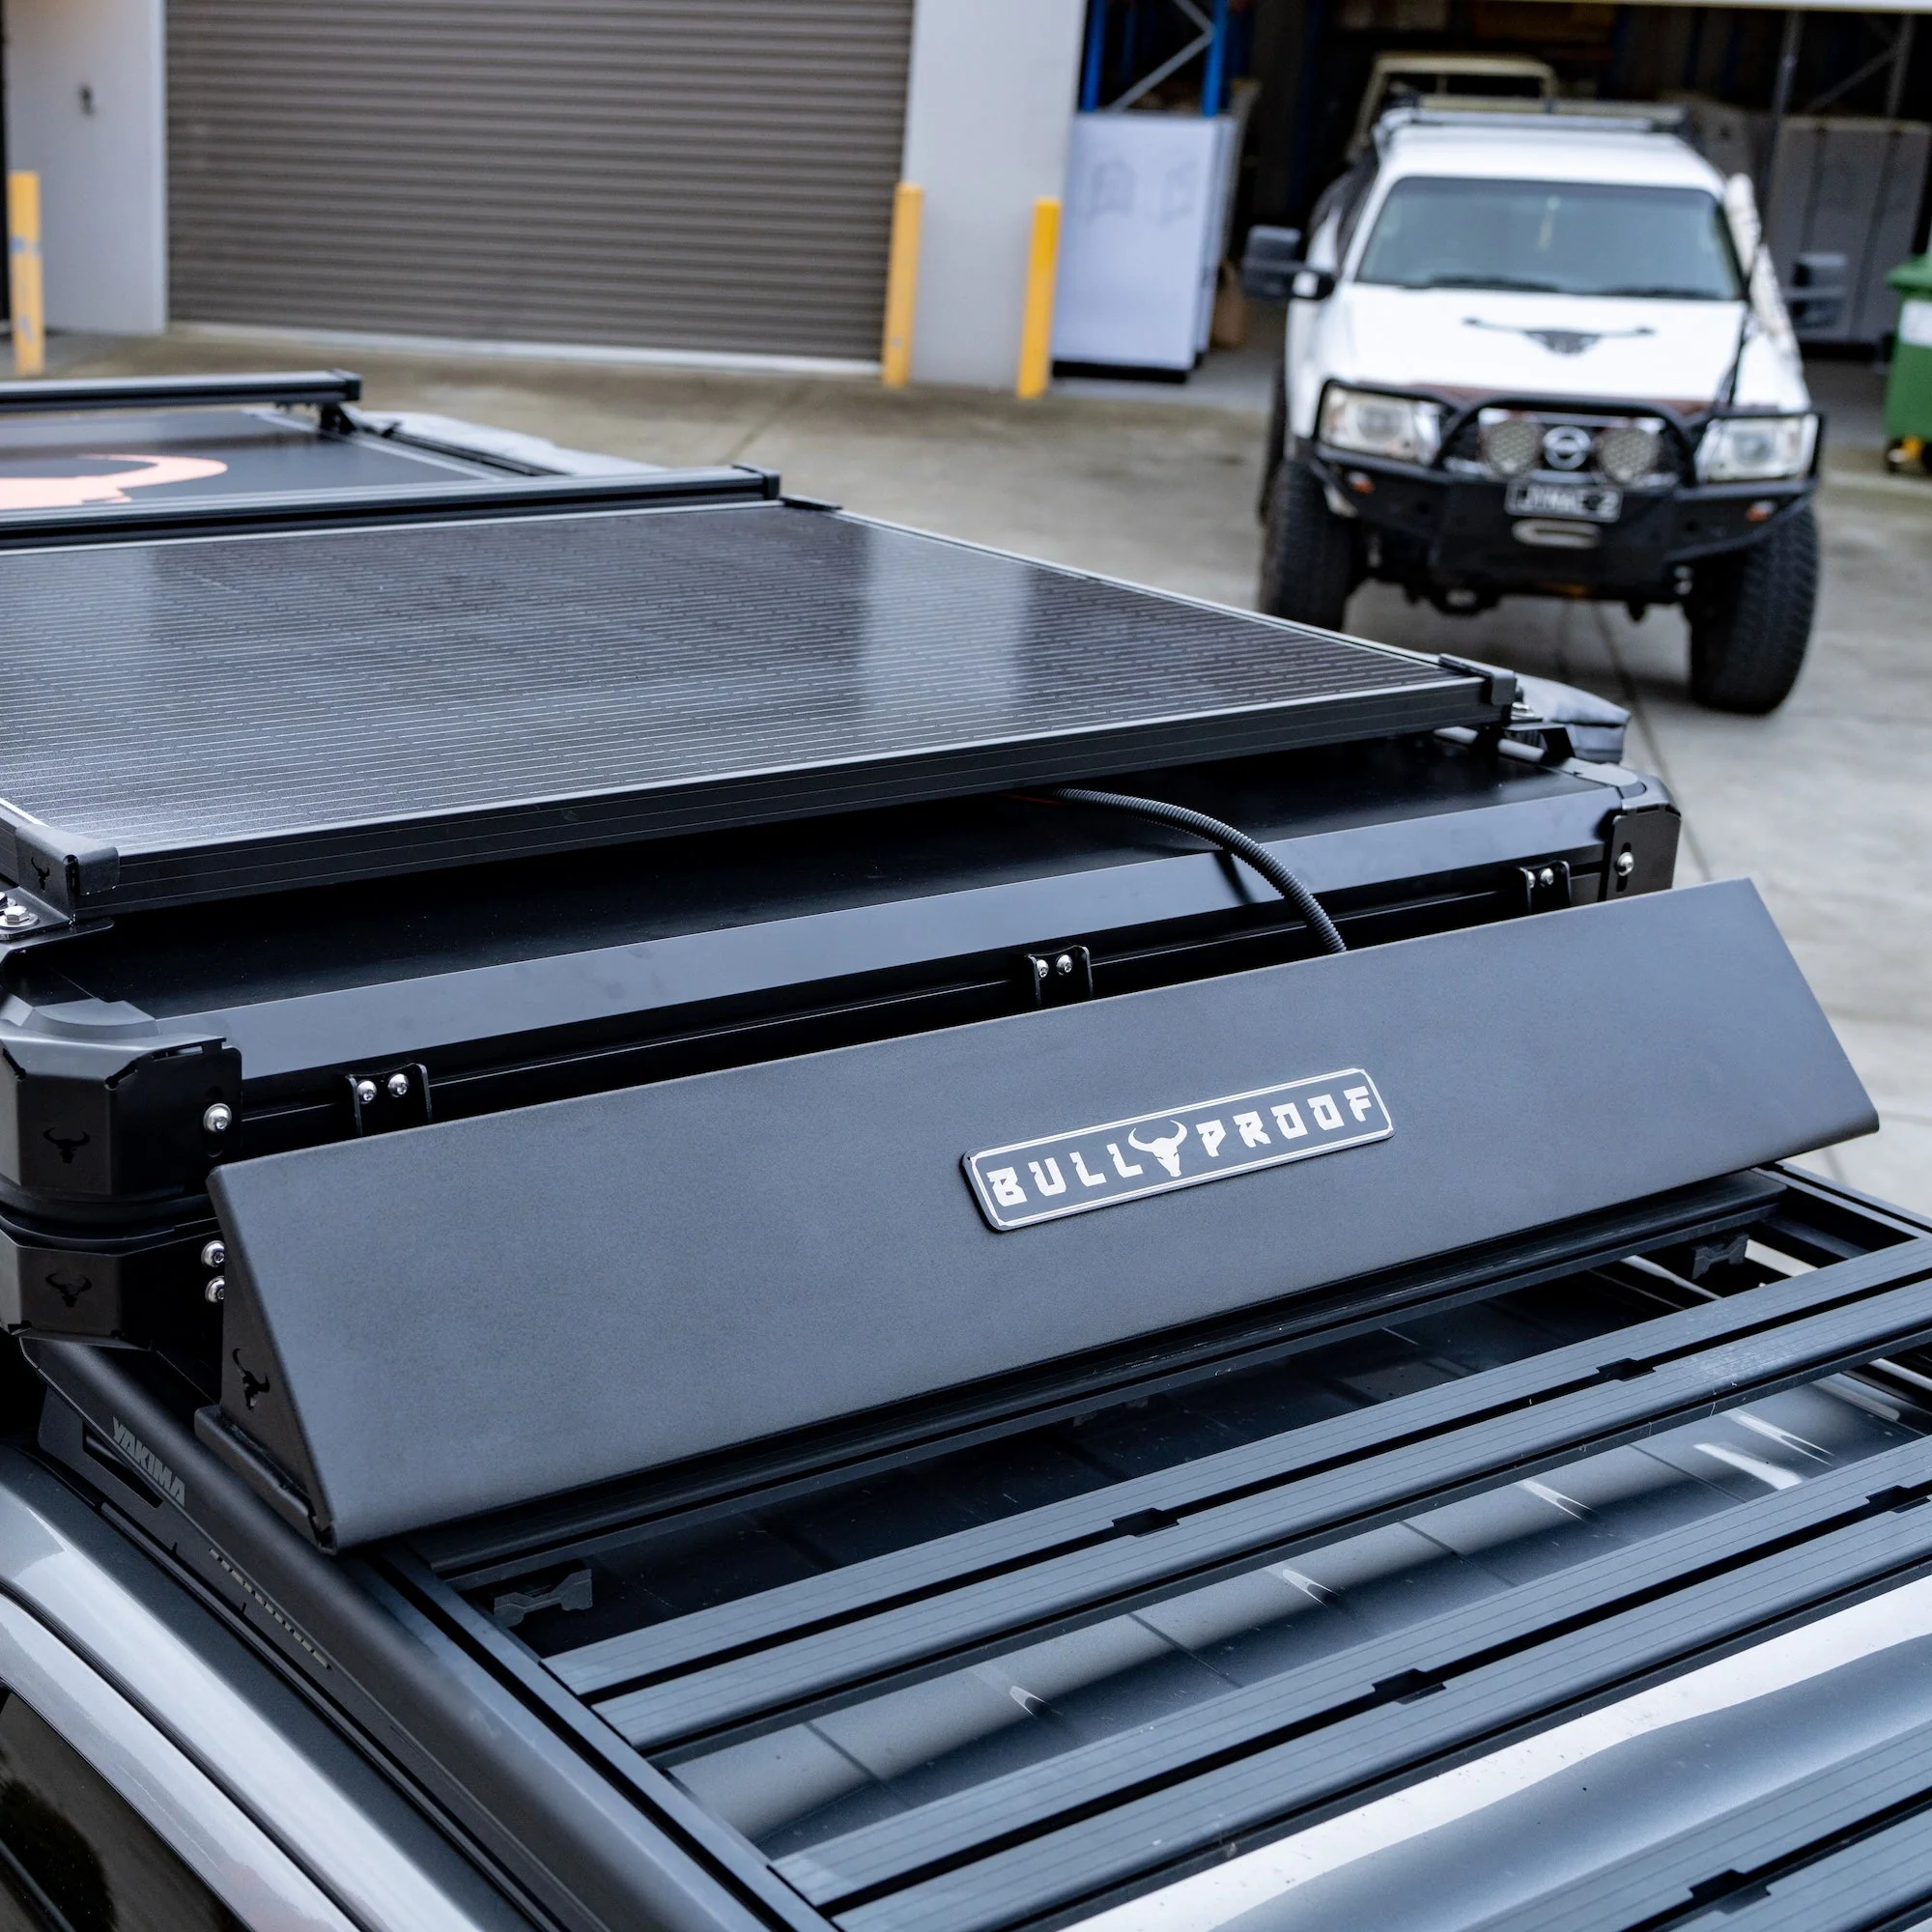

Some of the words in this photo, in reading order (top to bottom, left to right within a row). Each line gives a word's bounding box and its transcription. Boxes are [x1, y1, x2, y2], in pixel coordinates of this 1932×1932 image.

[986, 1142, 1145, 1208] BULL
[1195, 1085, 1373, 1158] PROOF
[112, 1415, 185, 1508] YAKIMA
